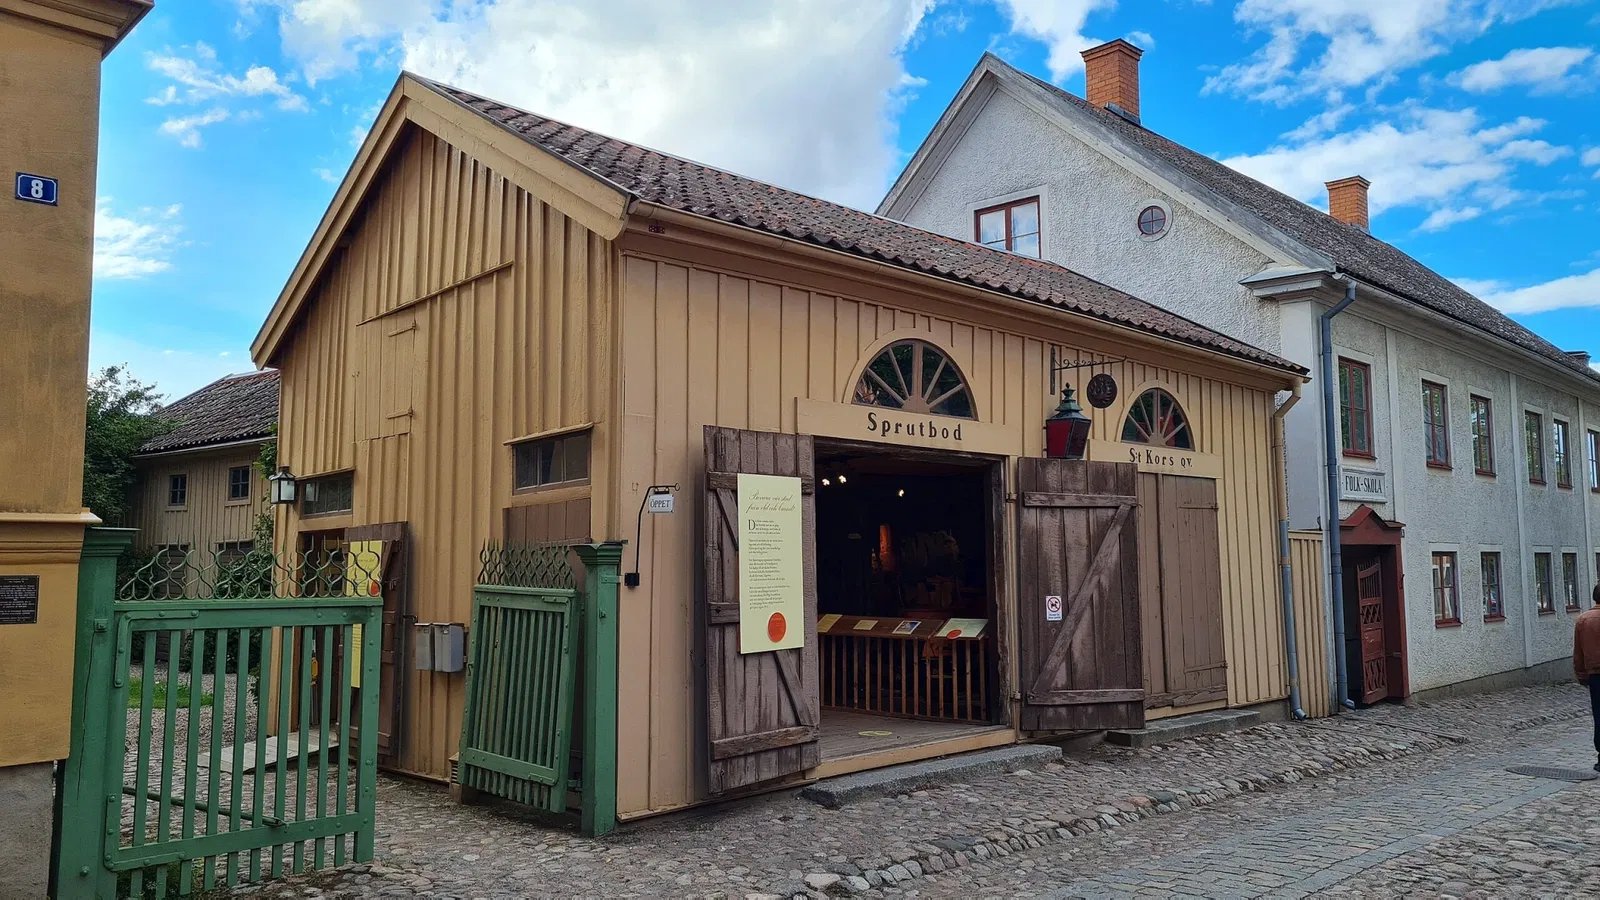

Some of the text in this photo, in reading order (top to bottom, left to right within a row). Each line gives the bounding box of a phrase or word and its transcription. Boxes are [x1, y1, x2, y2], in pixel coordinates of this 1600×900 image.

[31, 179, 43, 199] 8
[867, 411, 962, 441] Sprutbod
[1145, 449, 1174, 466] Kors
[650, 499, 671, 508] ÖPPET
